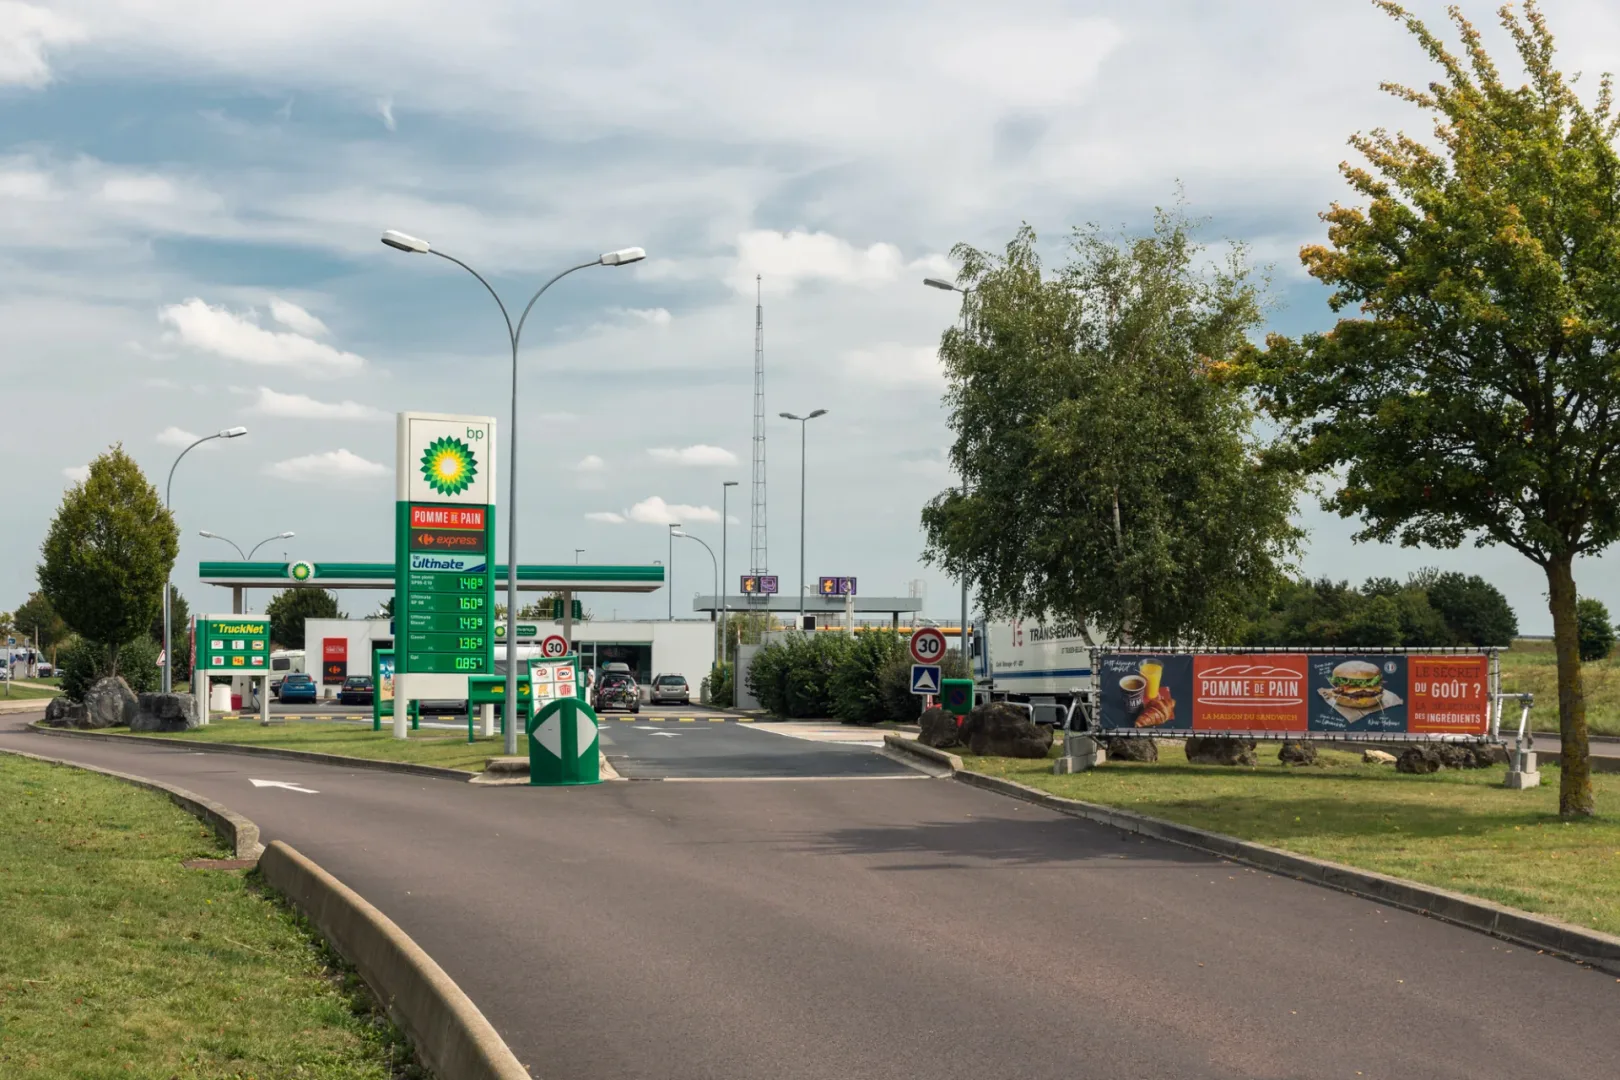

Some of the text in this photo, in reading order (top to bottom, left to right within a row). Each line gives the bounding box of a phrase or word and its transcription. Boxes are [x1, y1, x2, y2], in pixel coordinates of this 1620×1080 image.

[466, 426, 484, 441] bp
[414, 510, 481, 525] POMME DE PAIN
[436, 535, 478, 547] express
[219, 623, 264, 634] TruckNet
[547, 642, 562, 653] 30
[918, 638, 940, 654] 30
[1415, 666, 1481, 678] LE SECRET
[1202, 680, 1298, 697] POMME DE PAIN
[1414, 682, 1427, 693] DU
[1431, 679, 1468, 699] GOÛT
[1256, 713, 1298, 721] SANDWICH
[1426, 711, 1481, 724] INGRÉDIENTS
